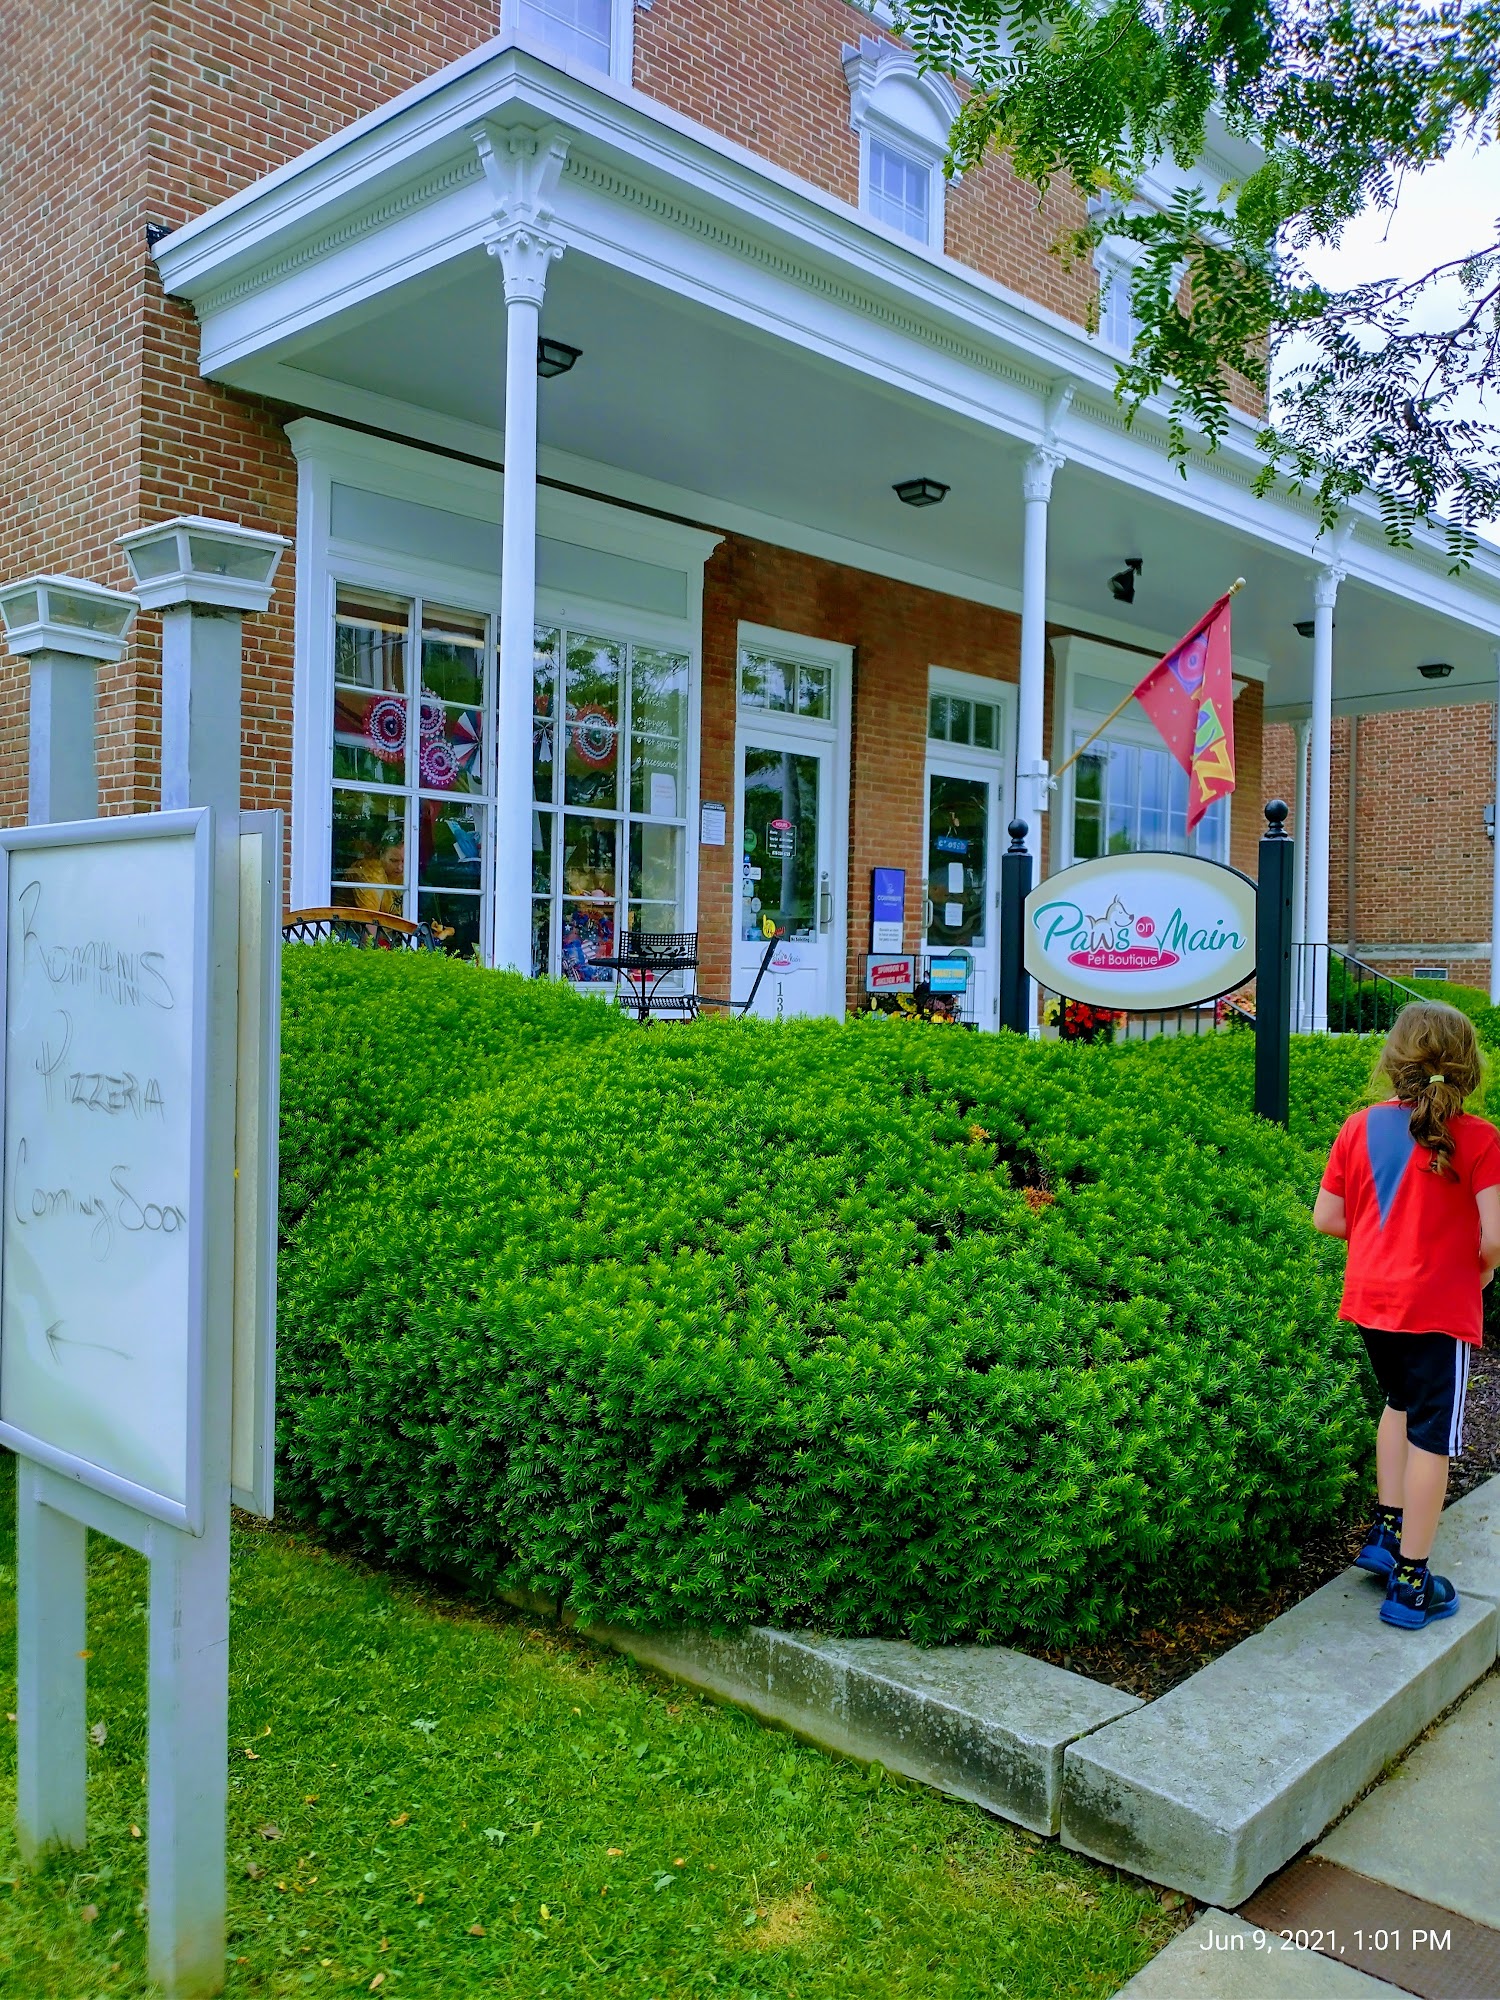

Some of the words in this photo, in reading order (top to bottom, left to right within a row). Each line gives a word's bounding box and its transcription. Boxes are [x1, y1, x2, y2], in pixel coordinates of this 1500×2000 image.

[1033, 901, 1130, 953] Paws
[1136, 922, 1154, 933] on
[1155, 907, 1246, 961] Main
[1087, 954, 1106, 966] Pet
[1108, 954, 1158, 968] Boutique
